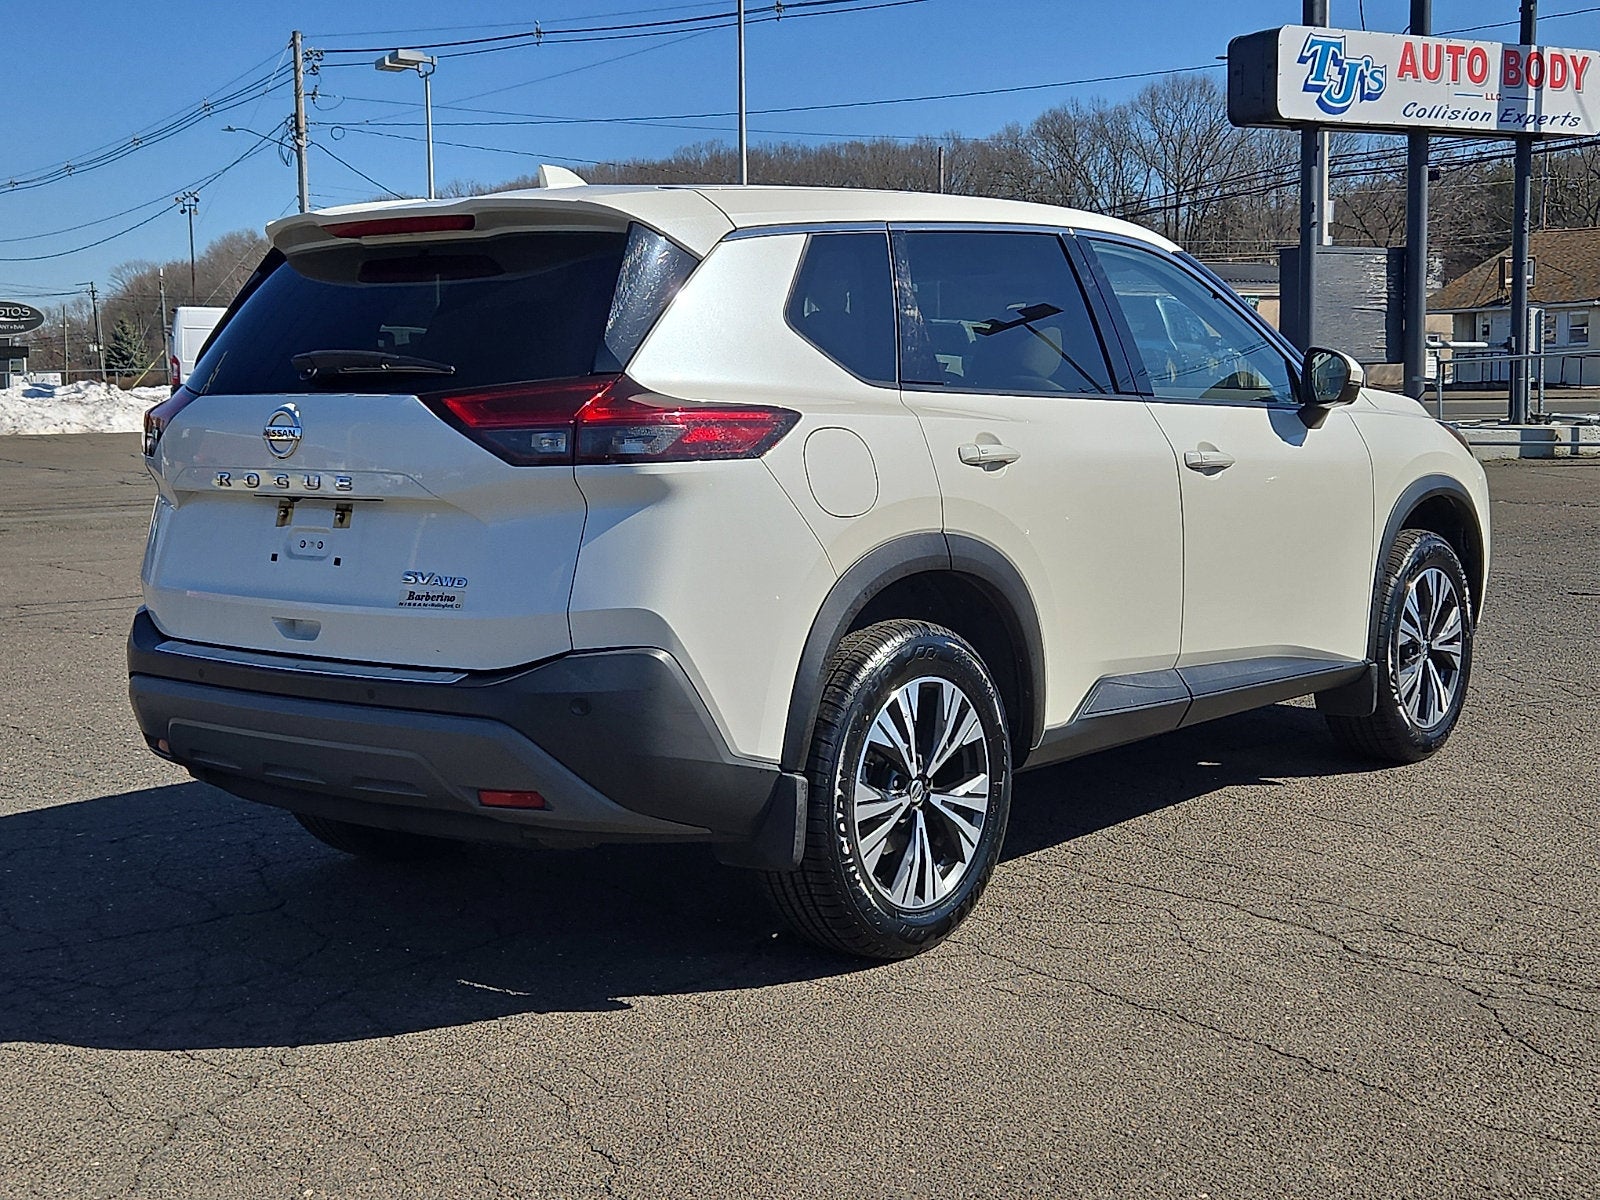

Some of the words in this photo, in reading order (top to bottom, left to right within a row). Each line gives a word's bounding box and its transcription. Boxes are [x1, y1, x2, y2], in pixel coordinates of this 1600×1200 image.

[1297, 32, 1388, 115] TJ's
[1397, 41, 1490, 86] AUTO
[1502, 49, 1590, 93] BODY
[1402, 101, 1493, 123] Collision
[1499, 107, 1582, 128] Experts
[264, 428, 296, 438] NISSAN
[217, 471, 353, 492] ROGUE
[401, 570, 435, 585] SV
[431, 575, 468, 588] AWD
[406, 591, 456, 603] Barberino
